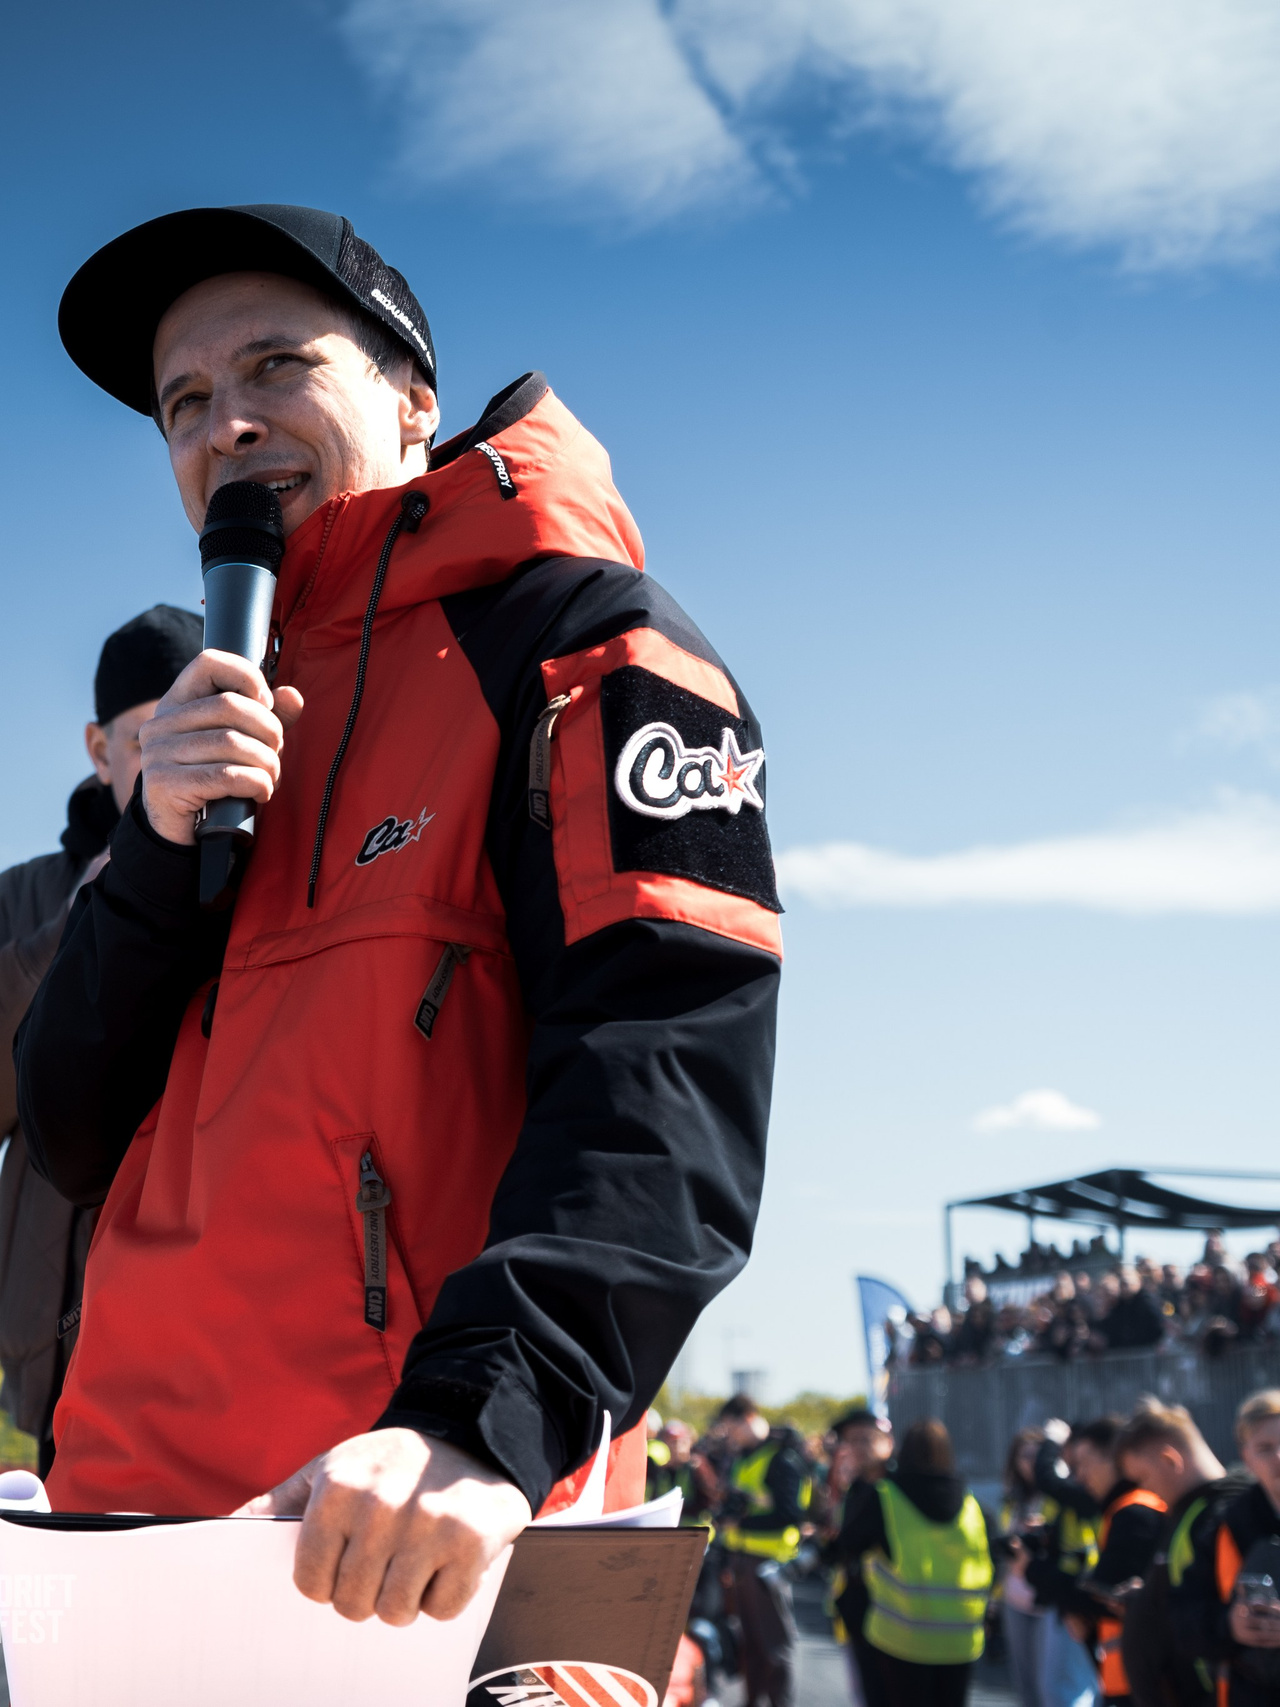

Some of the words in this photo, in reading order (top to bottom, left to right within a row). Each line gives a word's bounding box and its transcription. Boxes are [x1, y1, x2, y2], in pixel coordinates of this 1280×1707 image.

[474, 441, 513, 488] DESTROY
[535, 739, 545, 784] DESTROY
[369, 1210, 379, 1232] AND
[370, 1233, 380, 1280] DESTROY
